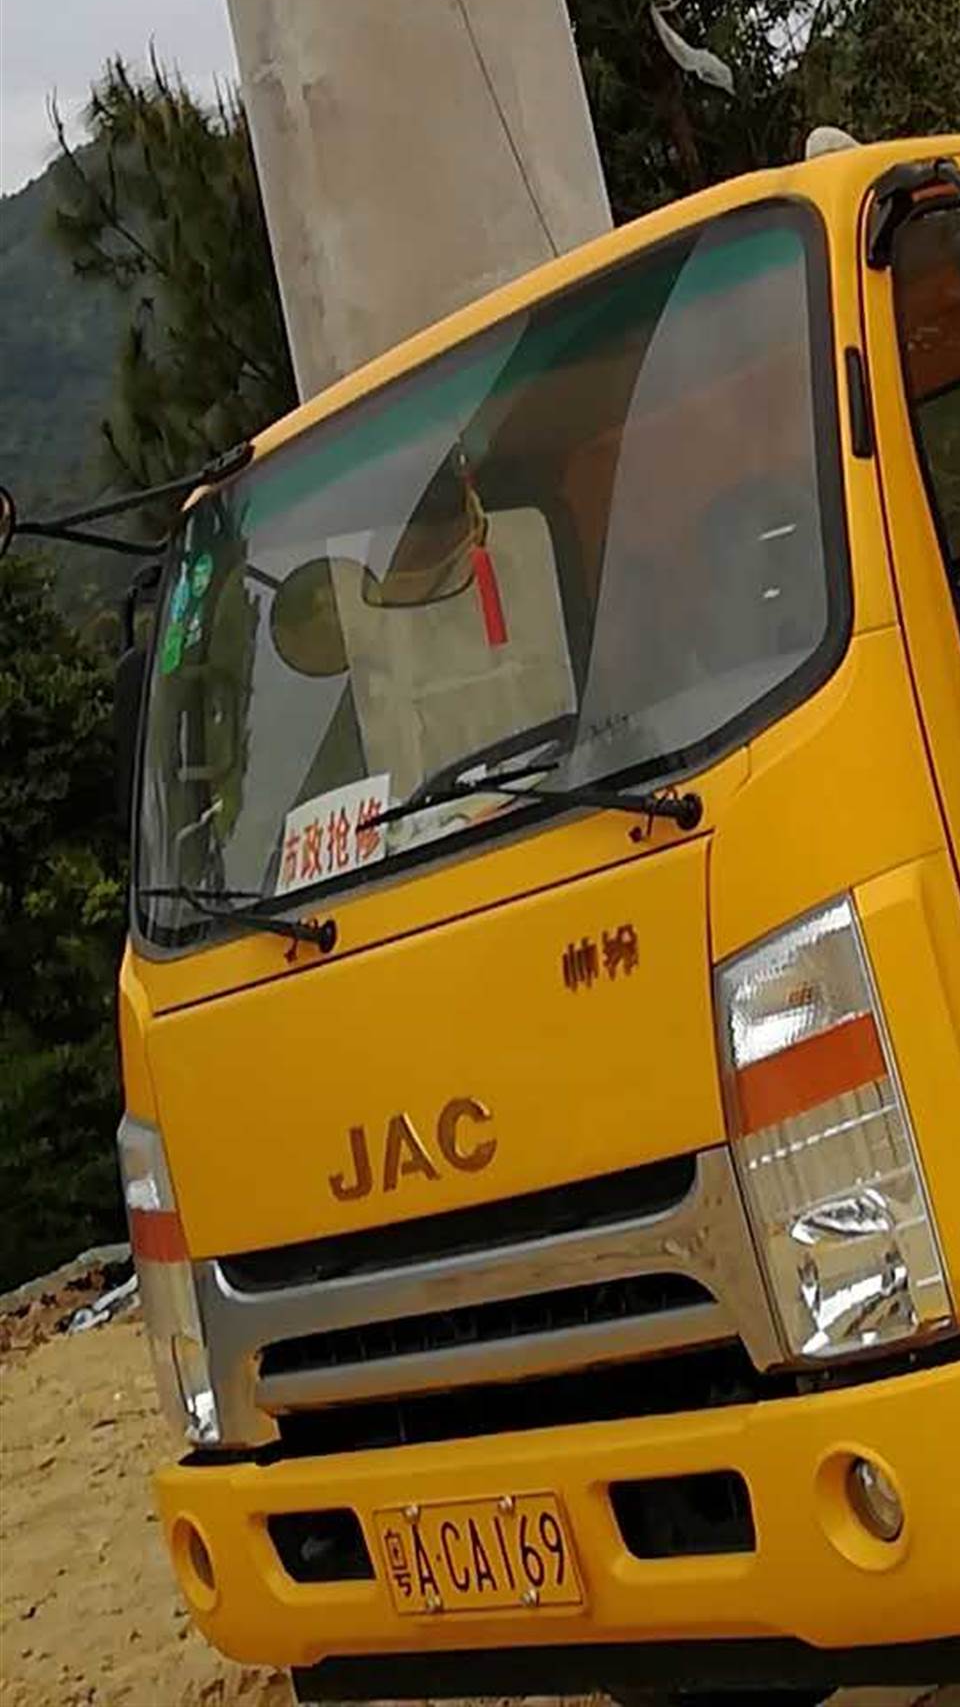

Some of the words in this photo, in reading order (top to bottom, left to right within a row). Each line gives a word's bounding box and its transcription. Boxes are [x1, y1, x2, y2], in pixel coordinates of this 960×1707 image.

[282, 797, 383, 888] 市政抢修
[328, 1096, 498, 1202] JAC
